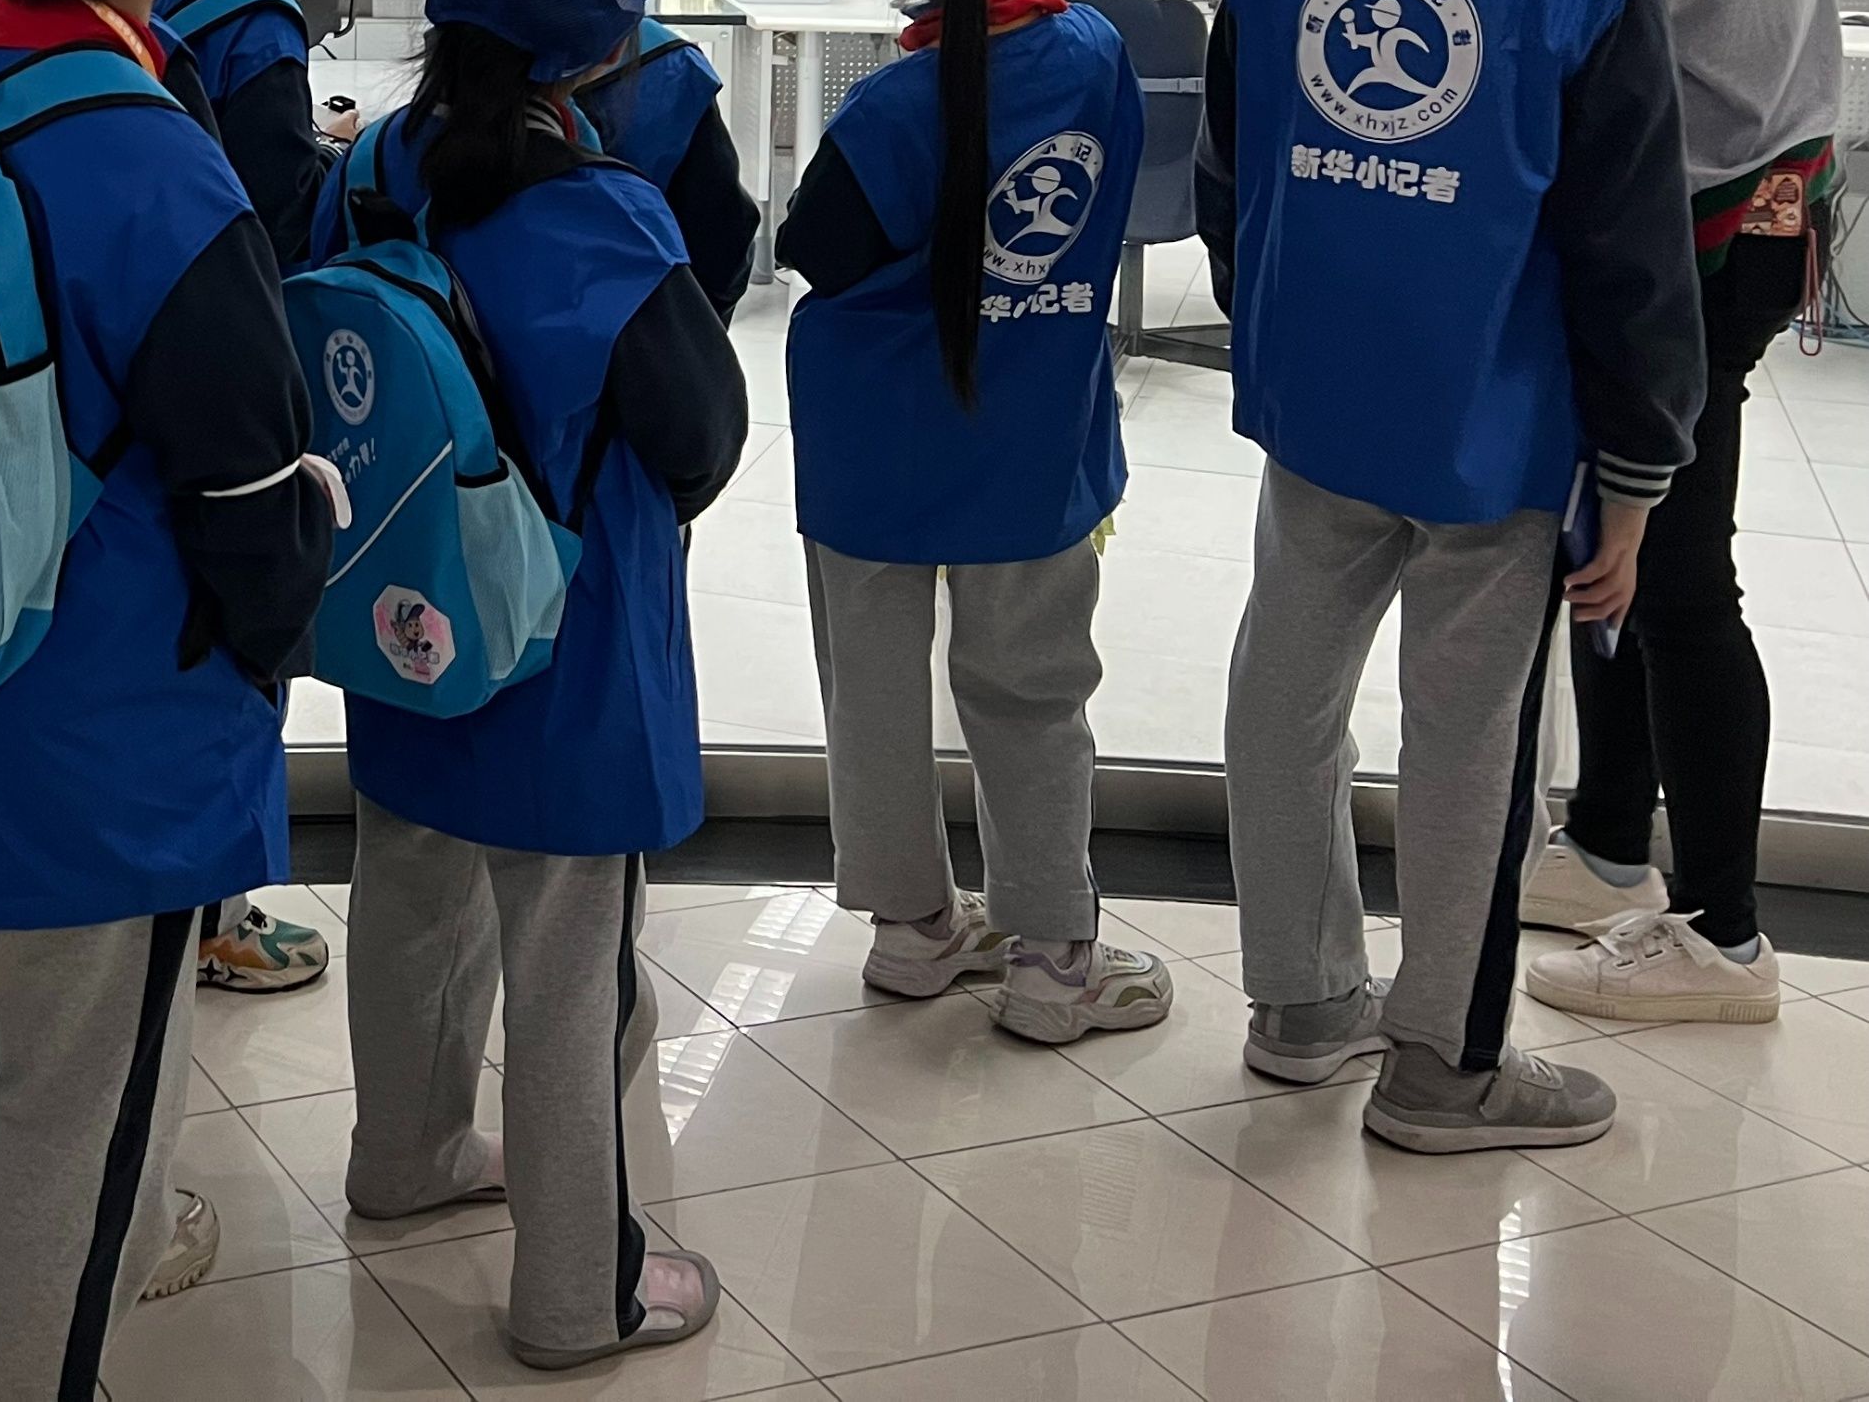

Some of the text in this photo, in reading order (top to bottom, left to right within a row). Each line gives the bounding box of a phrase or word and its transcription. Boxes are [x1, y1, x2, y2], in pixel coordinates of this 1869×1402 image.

[1291, 144, 1460, 204] 新华小记者
